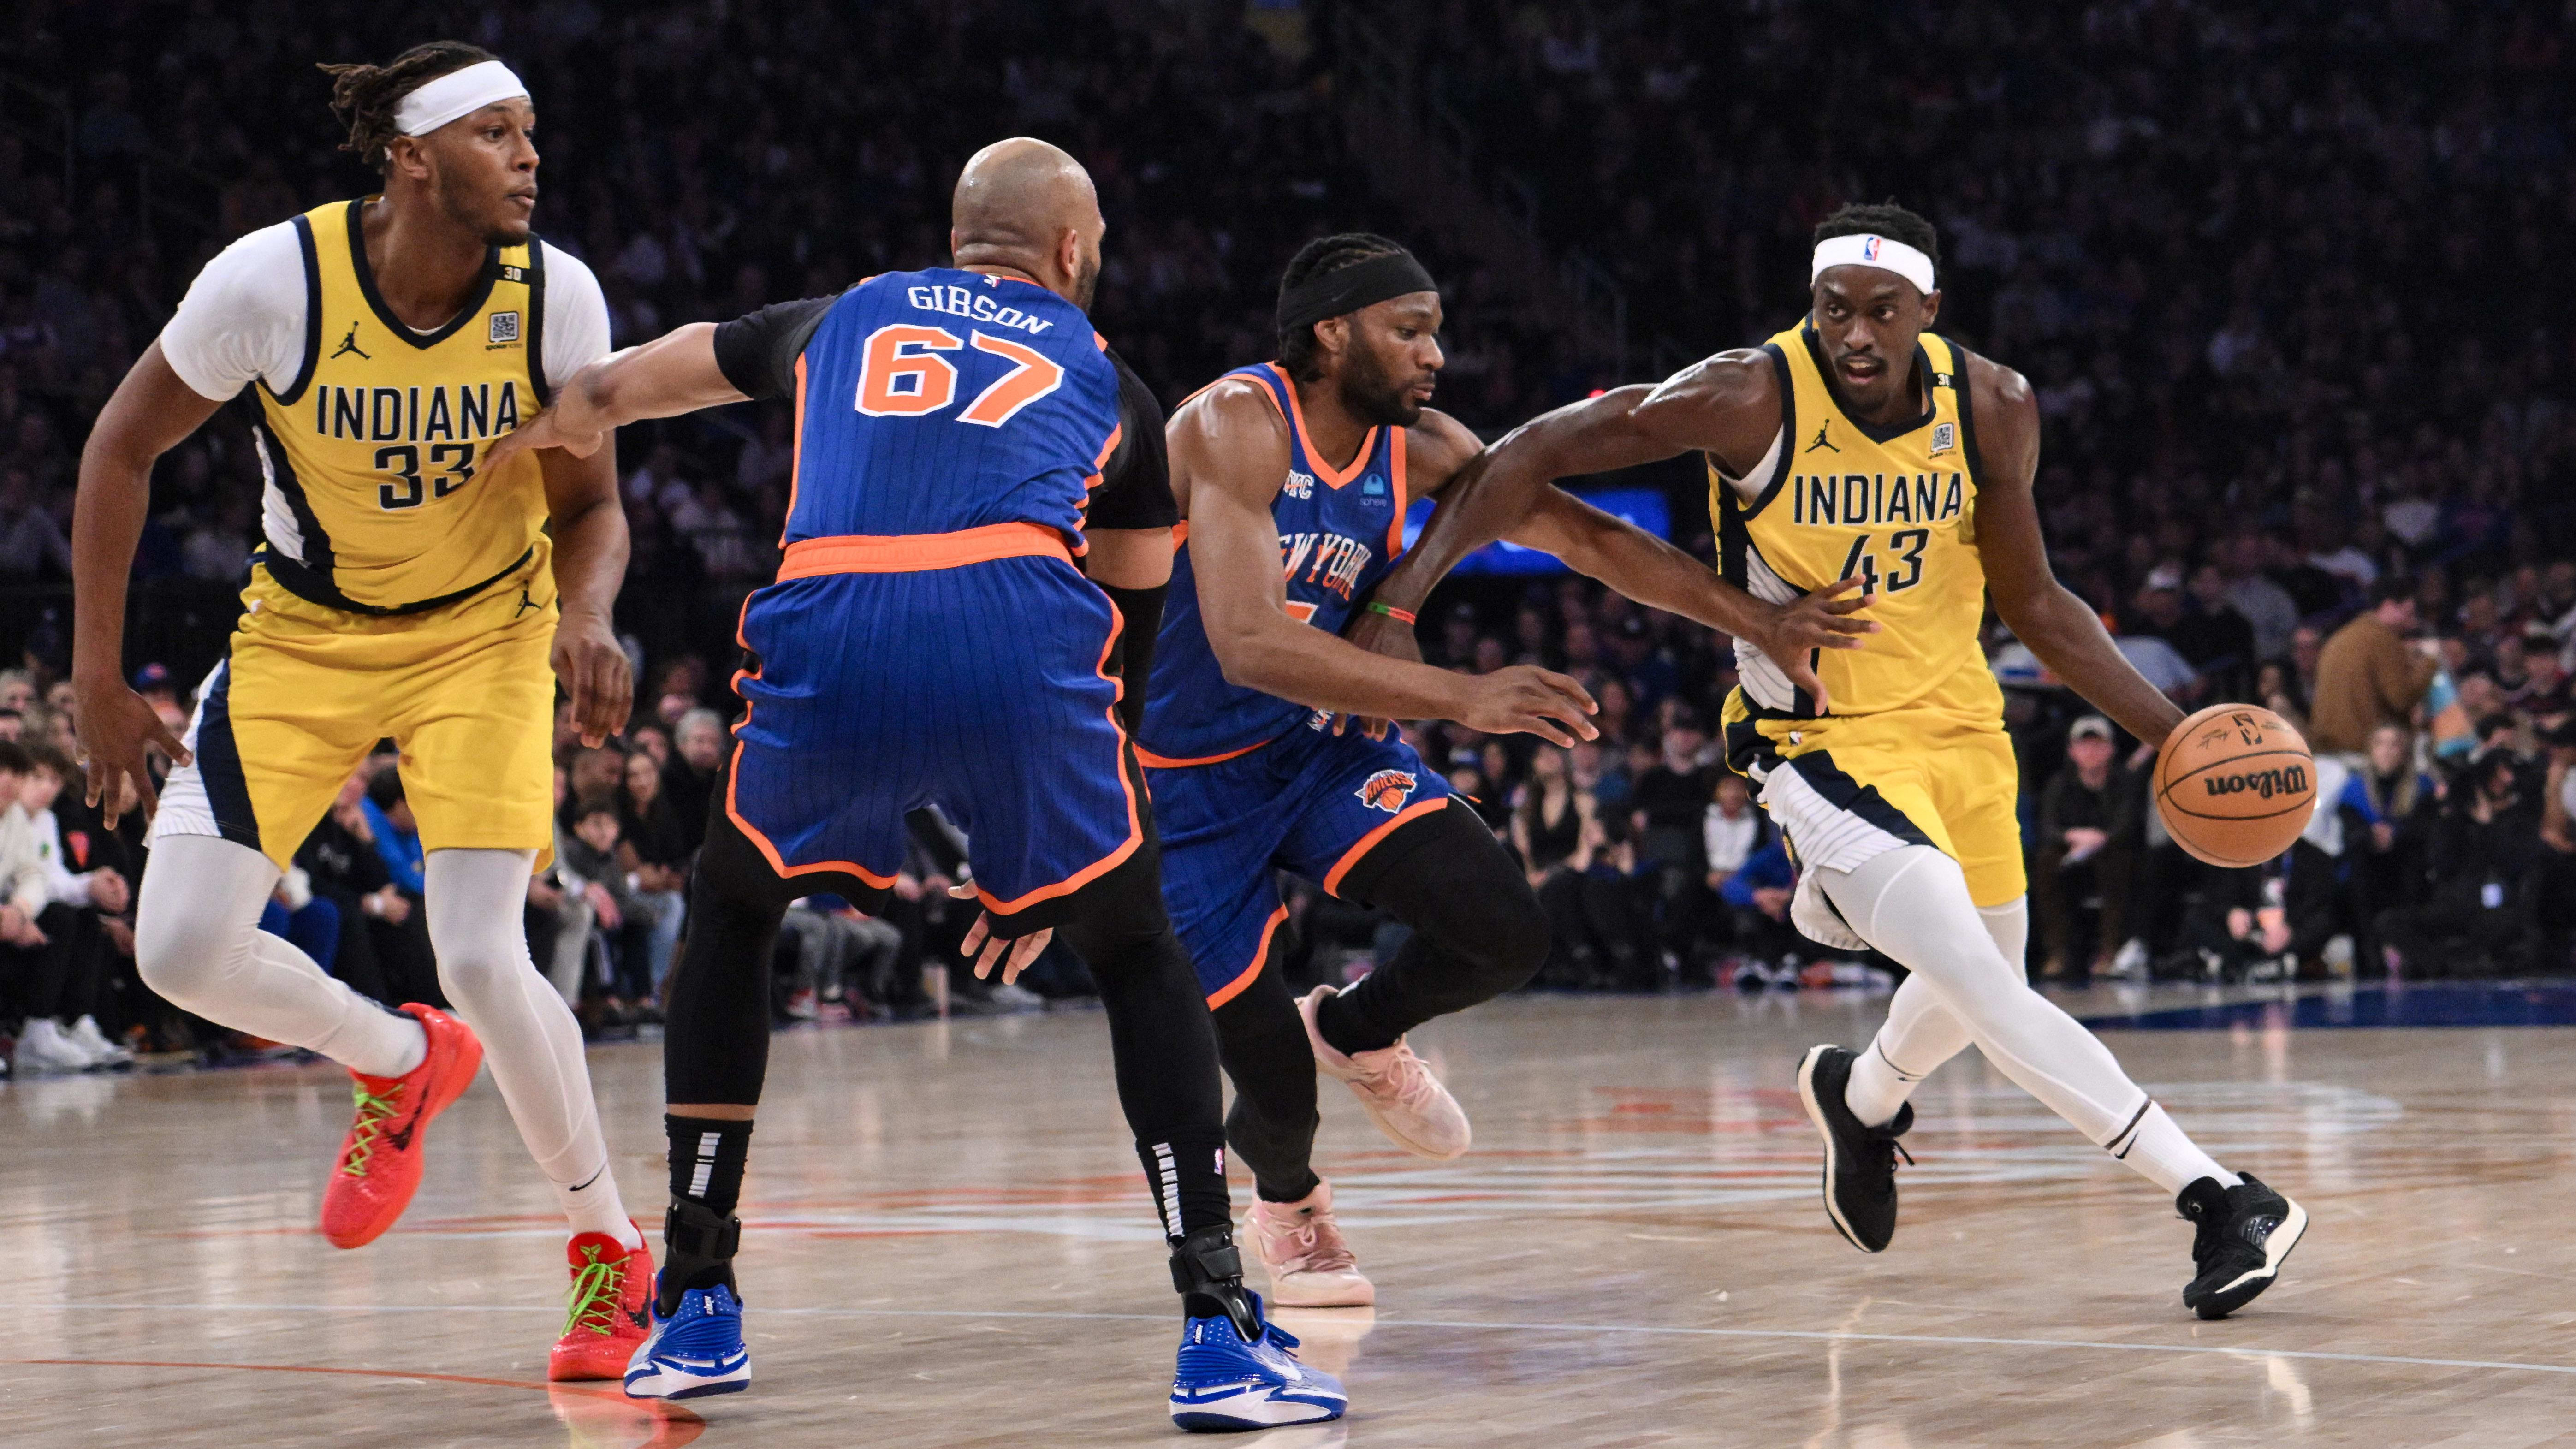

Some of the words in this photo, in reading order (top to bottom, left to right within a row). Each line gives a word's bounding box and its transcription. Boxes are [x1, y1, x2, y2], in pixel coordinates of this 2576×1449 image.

[504, 267, 522, 281] 30
[907, 285, 1054, 335] GIBSON
[855, 324, 1065, 428] 67
[316, 380, 519, 443] INDIANA
[374, 442, 475, 511] 33
[1793, 472, 1962, 526] INDIANA
[1306, 533, 1372, 601] YORK
[1838, 528, 1930, 598] 43
[1365, 772, 1415, 805] KNICKS
[2204, 764, 2308, 799] Wilson
